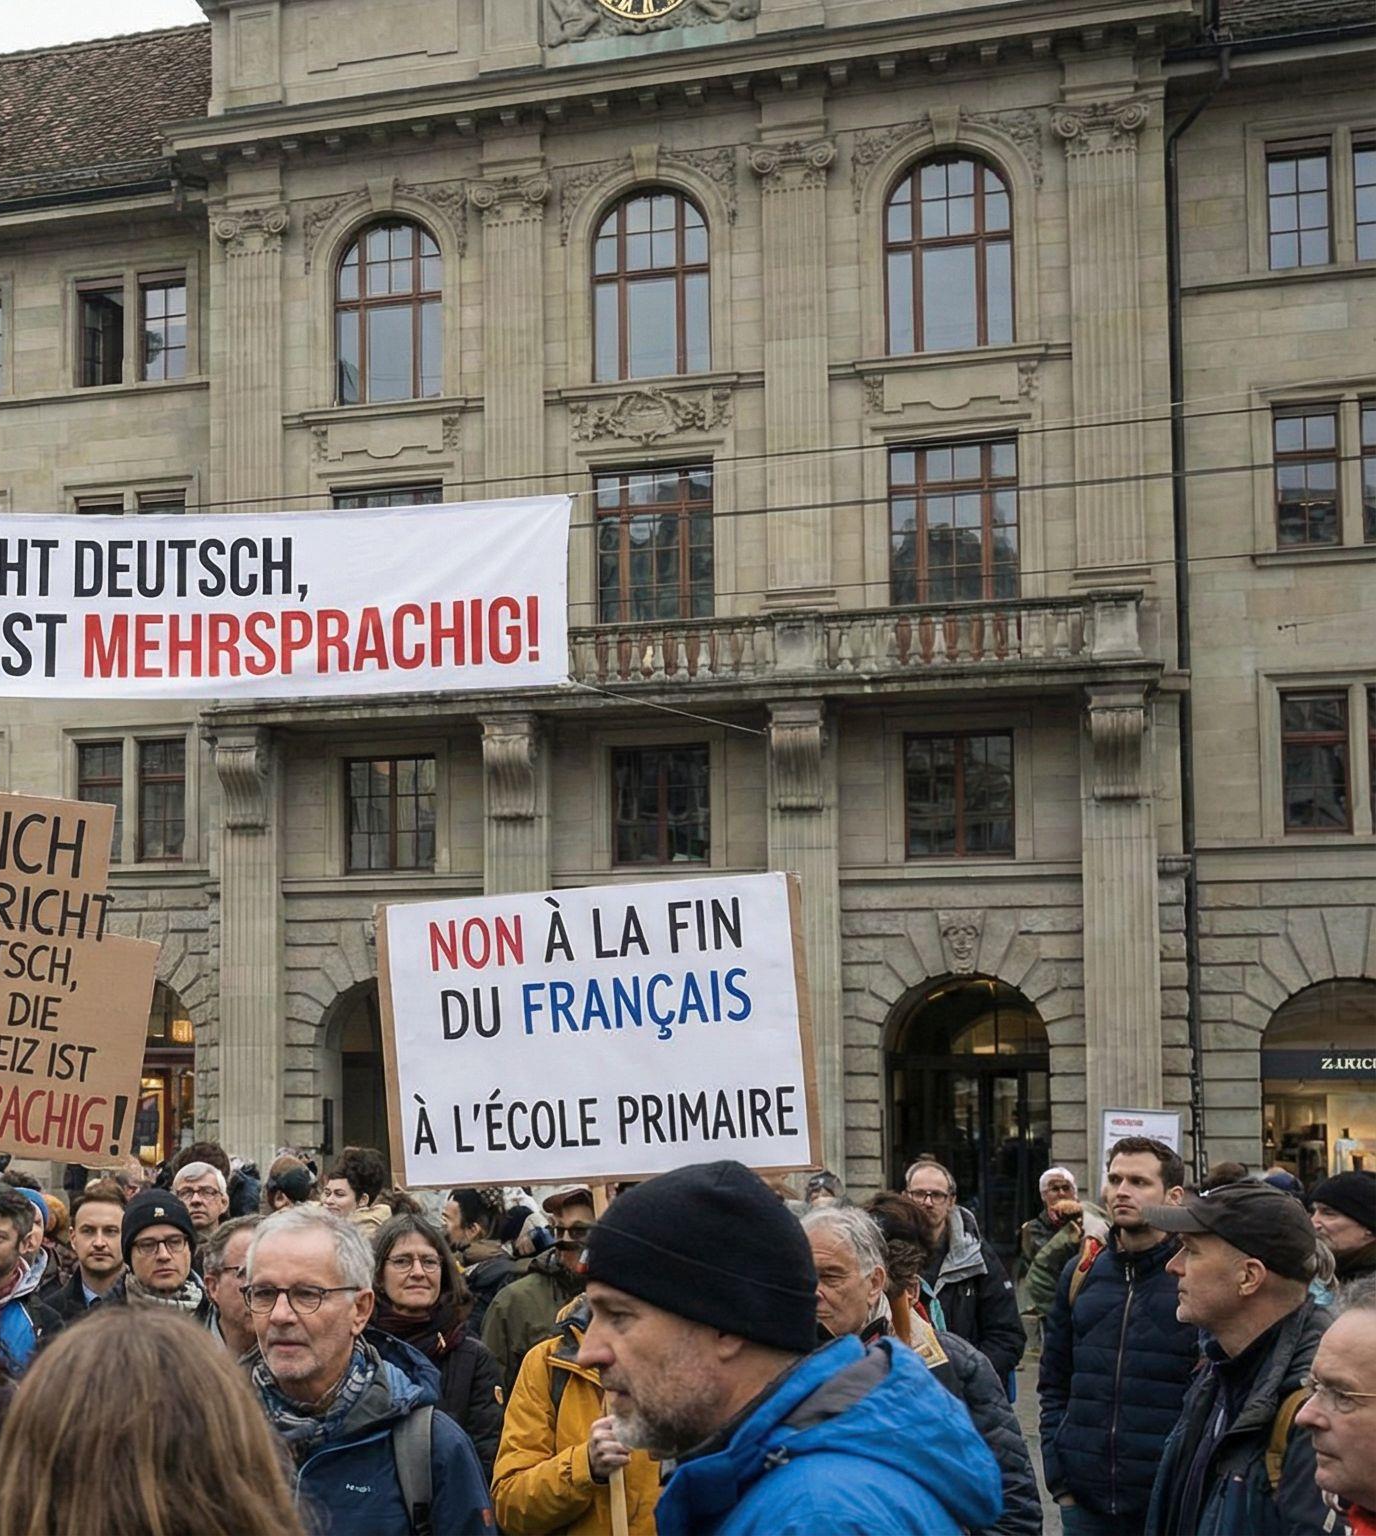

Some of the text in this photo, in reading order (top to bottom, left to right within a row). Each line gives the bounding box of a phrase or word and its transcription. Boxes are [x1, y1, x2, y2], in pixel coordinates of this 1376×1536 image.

[73, 537, 309, 602] DEUTSCH,
[83, 596, 539, 678] MEHRSPRACHIG!
[428, 896, 743, 972] NON À LA FIN
[7, 991, 63, 1031] DIE
[440, 967, 752, 1040] DU FRANÇAIS
[47, 1042, 96, 1082] IST
[413, 1085, 798, 1156] À L'ÉCOLE PRIMAIRE
